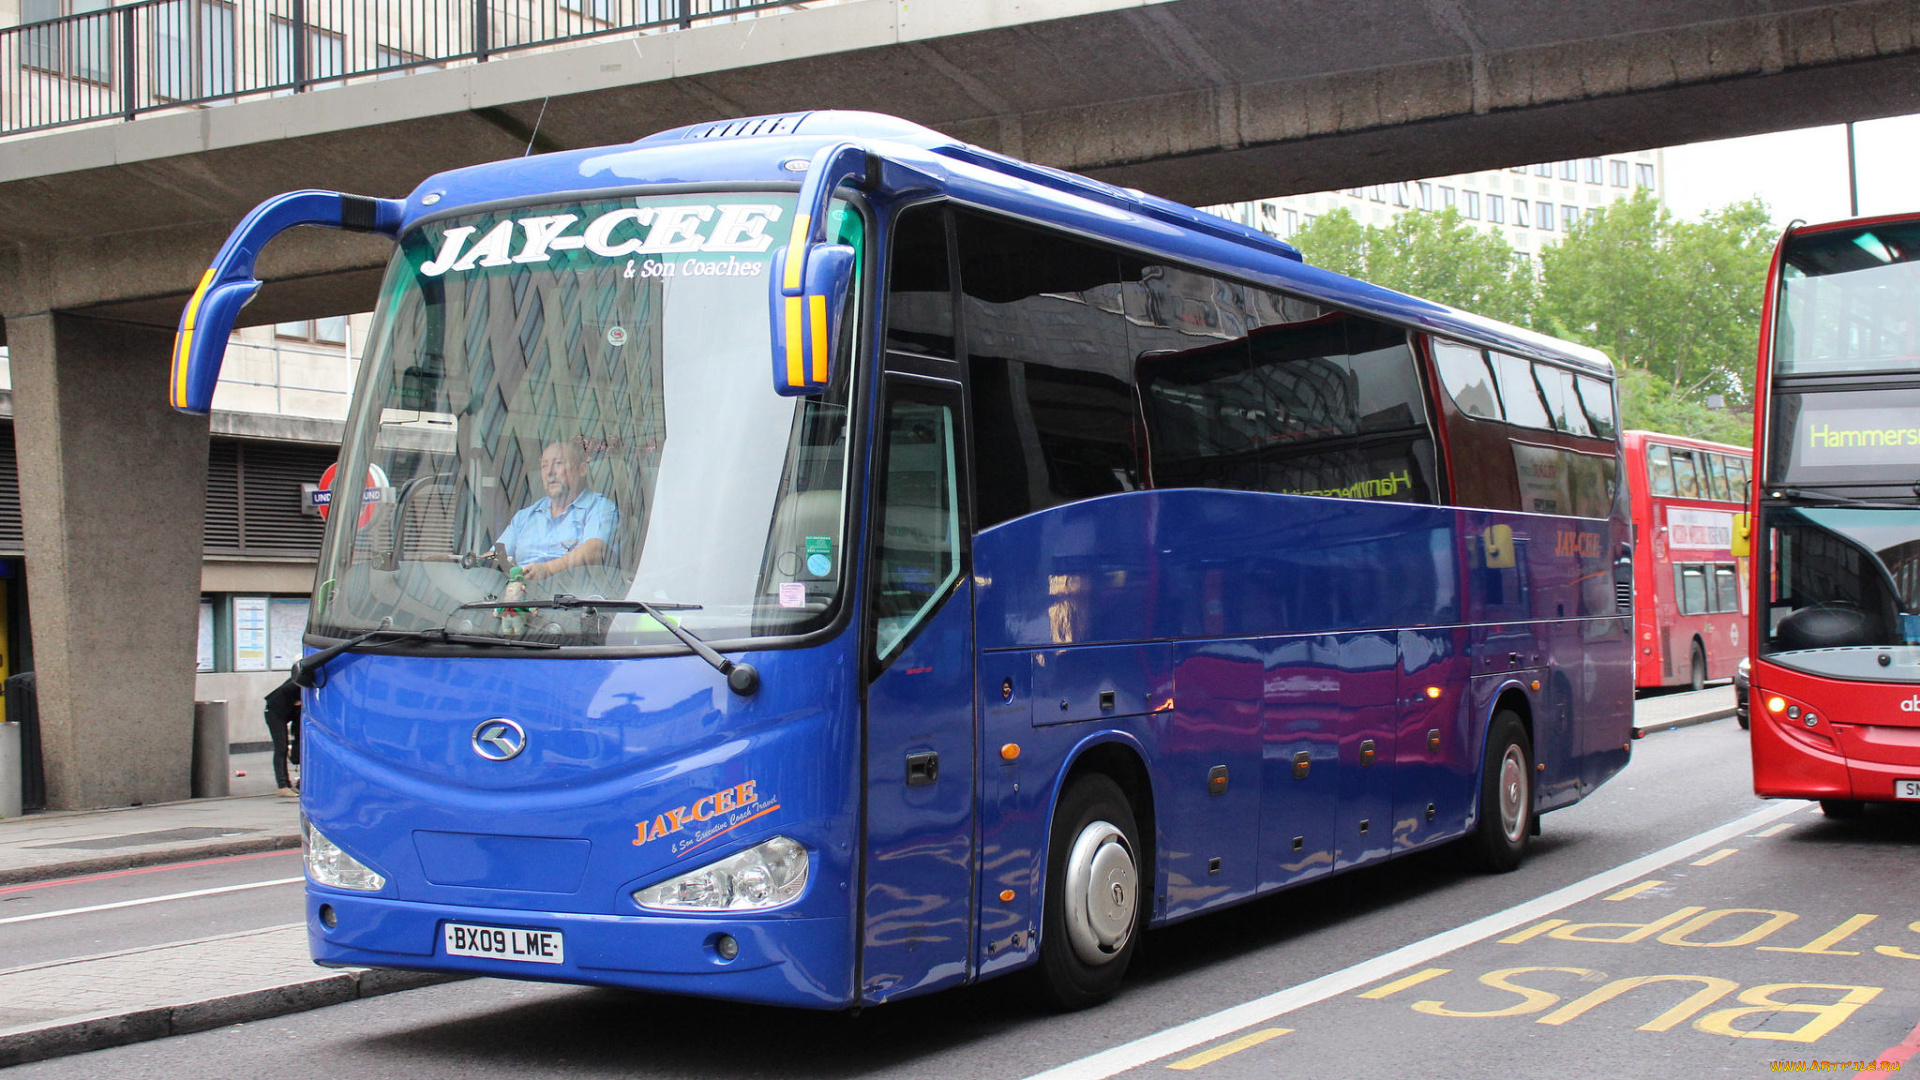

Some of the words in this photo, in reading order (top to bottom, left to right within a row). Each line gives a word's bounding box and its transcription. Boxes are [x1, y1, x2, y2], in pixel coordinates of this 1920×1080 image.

[420, 204, 783, 277] JAY-CEE
[623, 259, 636, 279] &
[641, 259, 675, 278] Son
[682, 255, 762, 277] Coaches
[1810, 424, 1920, 448] Hammers
[1555, 530, 1601, 557] JAY-CEE
[632, 779, 759, 847] JAY-CEE
[671, 844, 678, 854] &
[679, 839, 694, 851] Son
[694, 821, 728, 842] Executive
[729, 806, 752, 826] Coach
[752, 794, 778, 812] Travel
[454, 926, 506, 953] BX09
[511, 931, 554, 957] LME
[1411, 966, 1884, 1043] BUS
